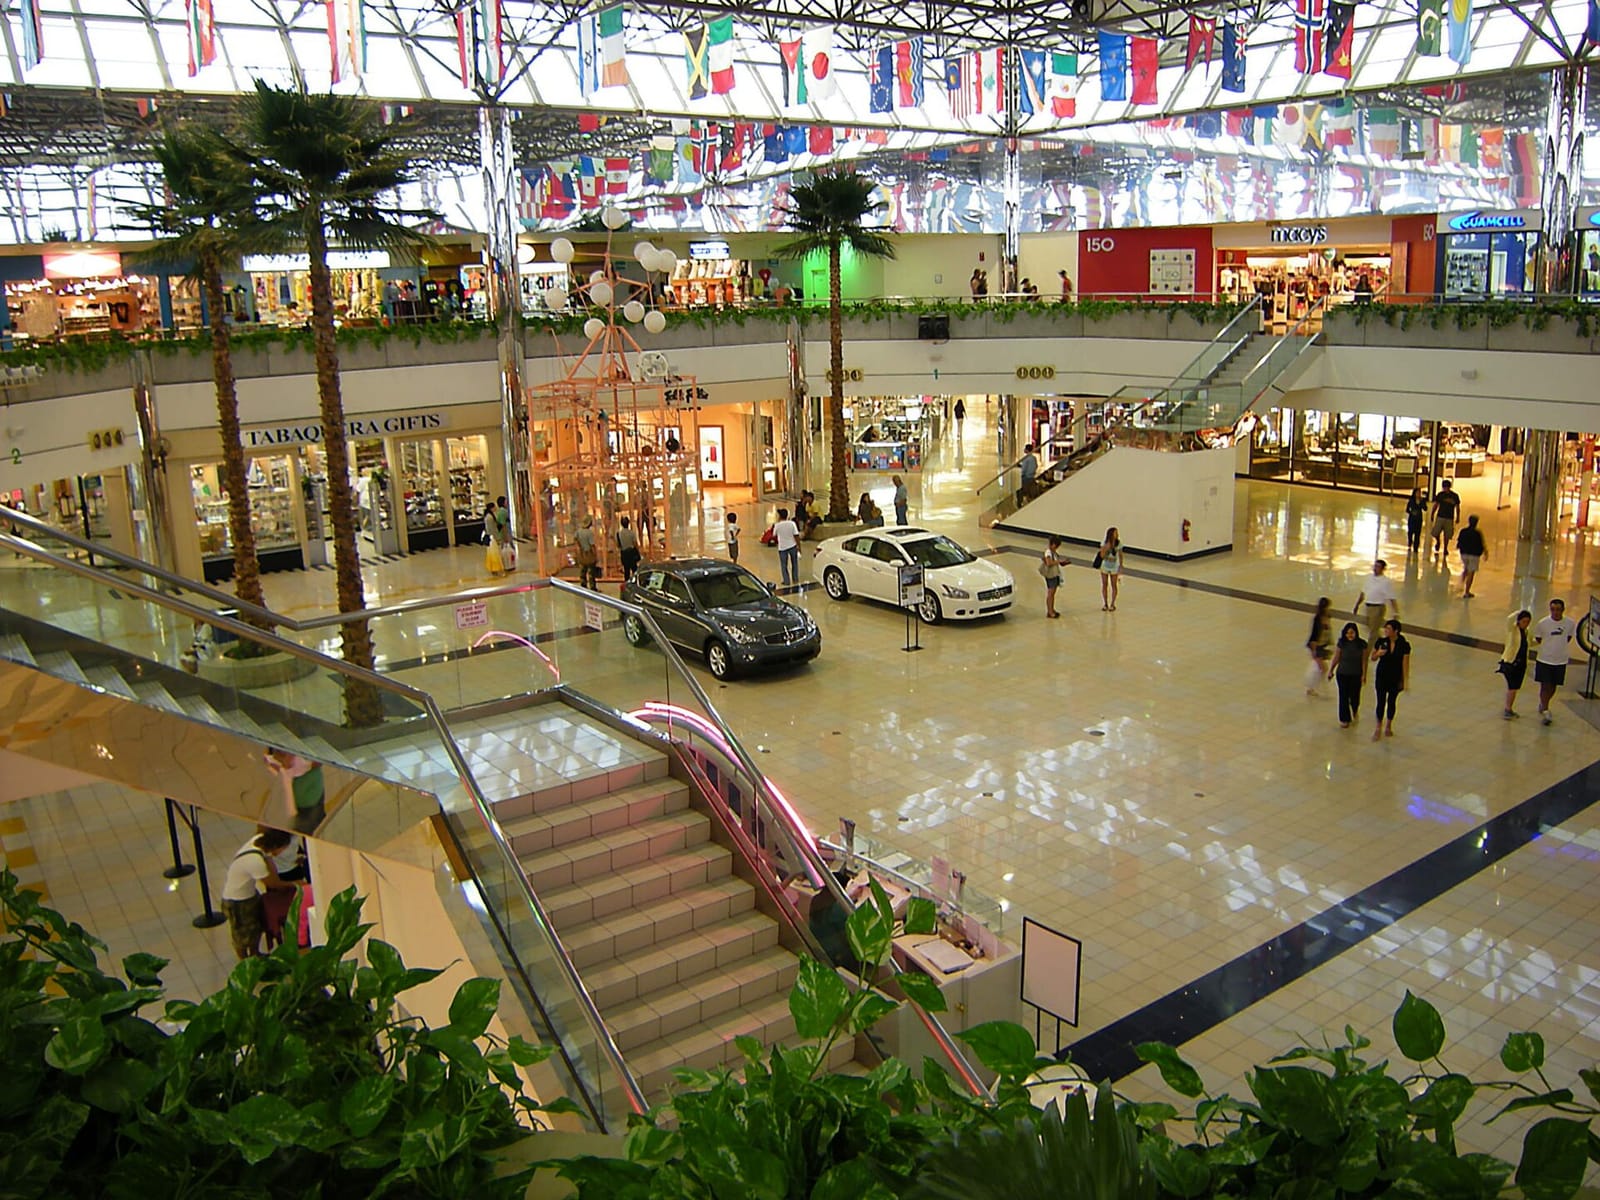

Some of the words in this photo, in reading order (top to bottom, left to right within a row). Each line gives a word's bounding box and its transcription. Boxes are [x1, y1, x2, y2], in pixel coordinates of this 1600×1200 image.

[1461, 215, 1526, 229] GUAMCELL
[1086, 238, 1114, 252] 150
[246, 421, 380, 445] TABAQRA
[384, 414, 441, 433] GIFTS
[11, 448, 22, 464] 2
